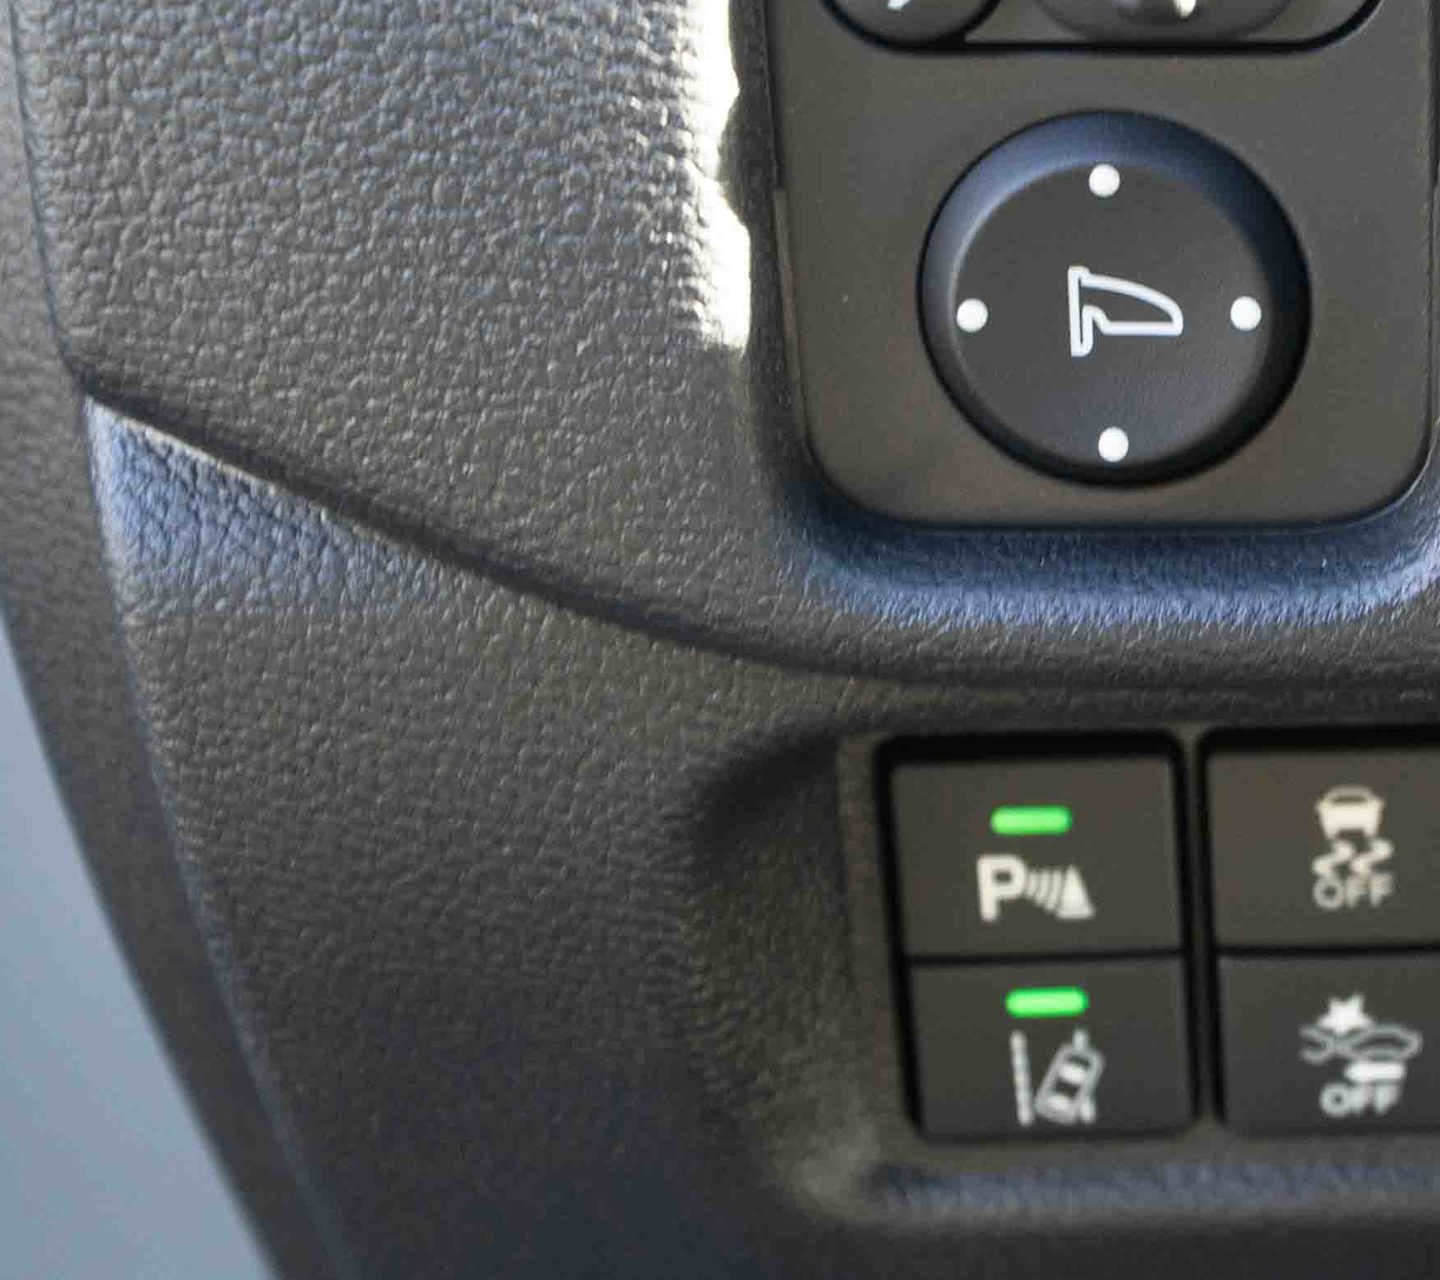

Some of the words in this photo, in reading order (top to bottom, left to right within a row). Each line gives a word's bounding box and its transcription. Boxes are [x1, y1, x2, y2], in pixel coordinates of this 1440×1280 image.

[976, 853, 1024, 922] P
[1312, 873, 1394, 912] OFF
[1319, 1080, 1404, 1117] OFF
